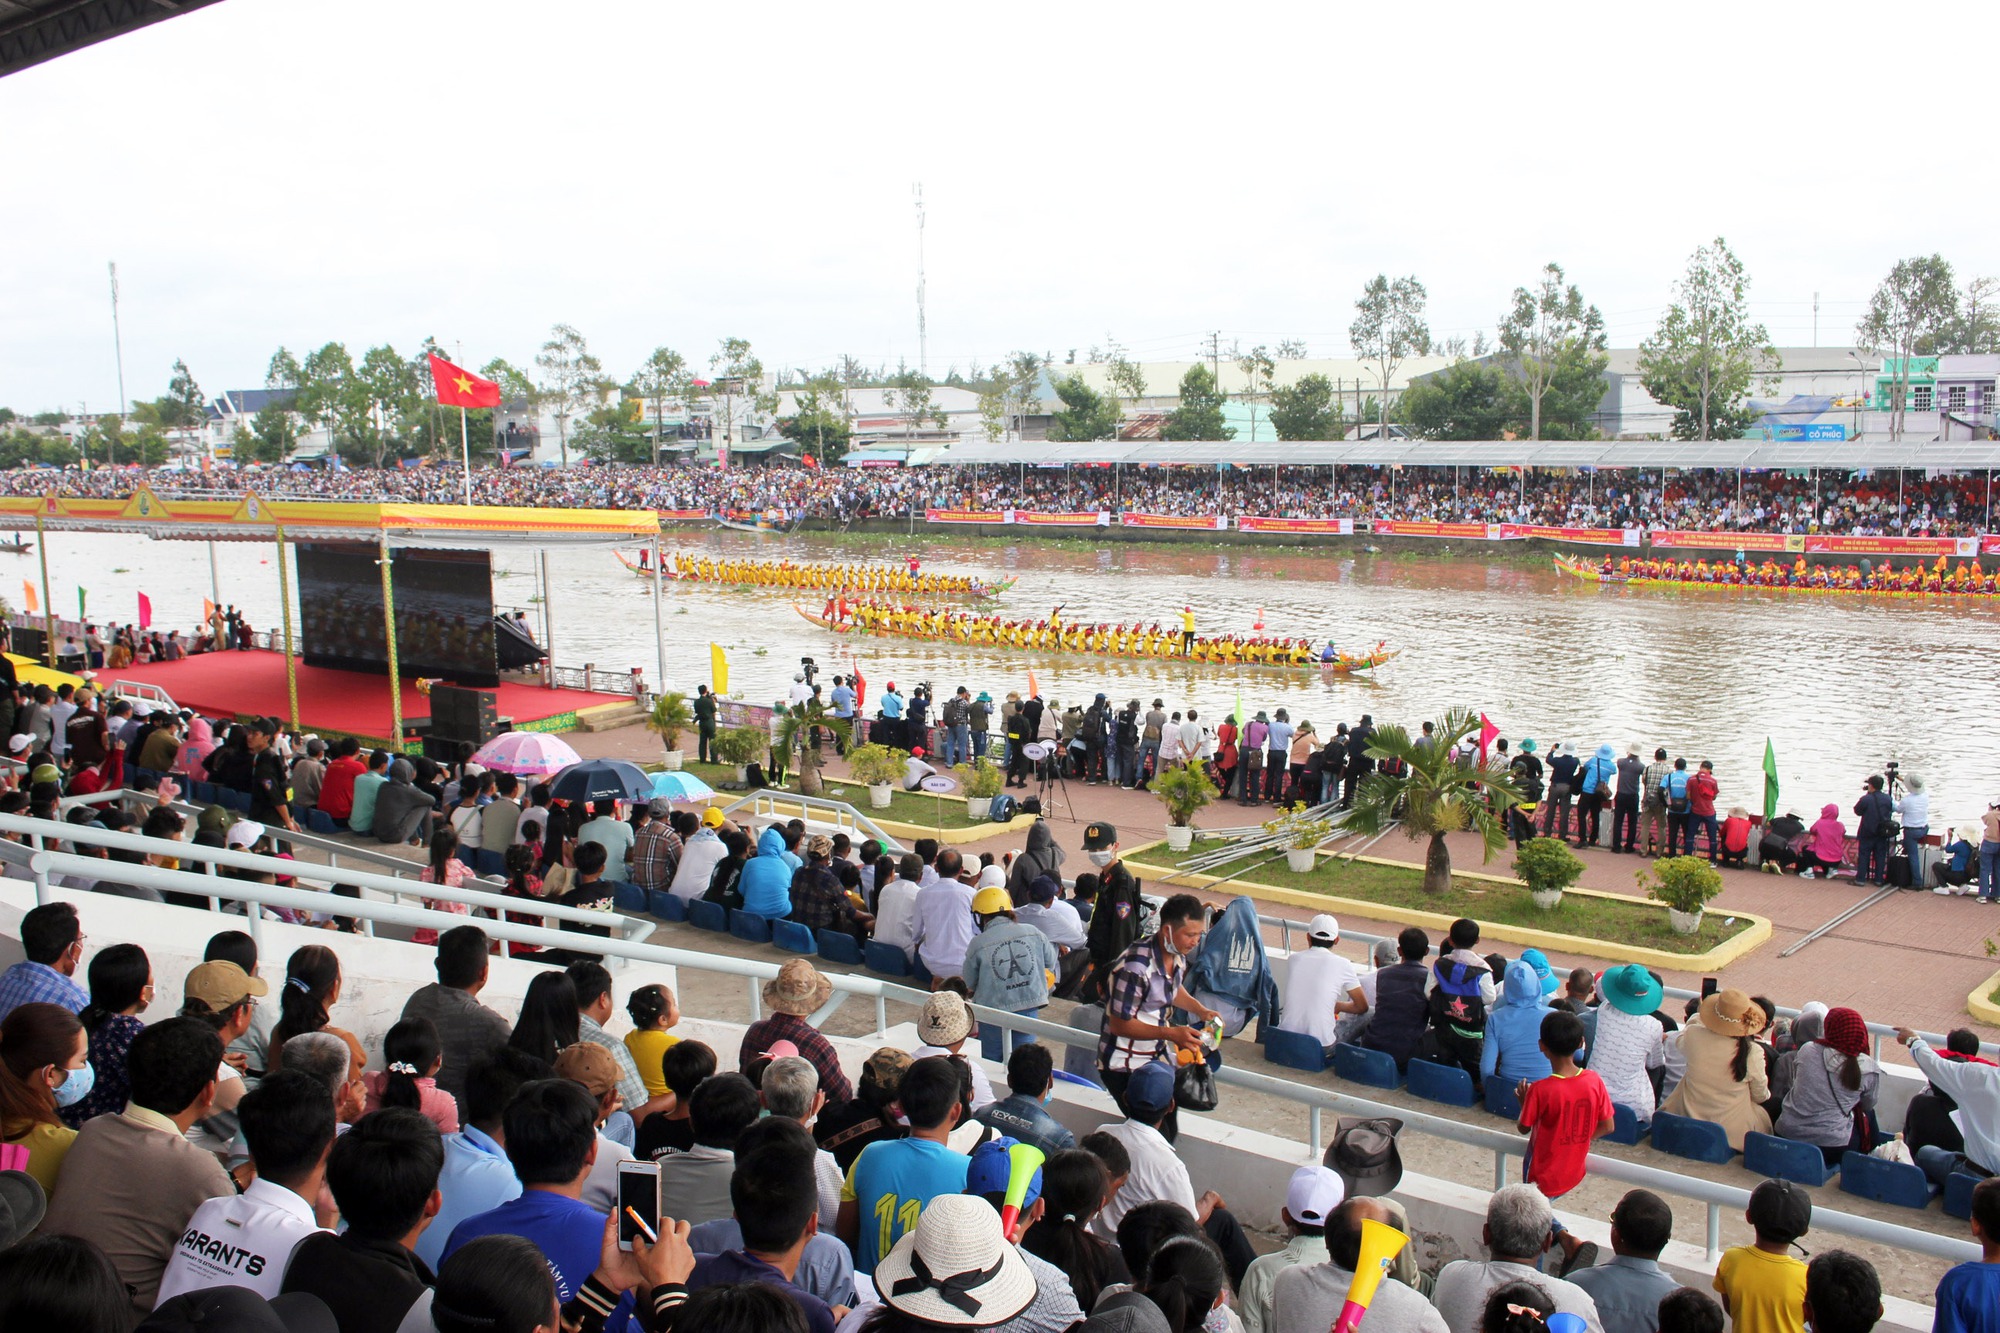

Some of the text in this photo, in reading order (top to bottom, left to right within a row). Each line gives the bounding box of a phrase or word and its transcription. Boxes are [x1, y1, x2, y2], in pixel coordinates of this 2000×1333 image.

[1808, 430, 1842, 438] CÔ PHÚC
[1560, 1098, 1592, 1145] 10
[874, 1192, 921, 1262] 11
